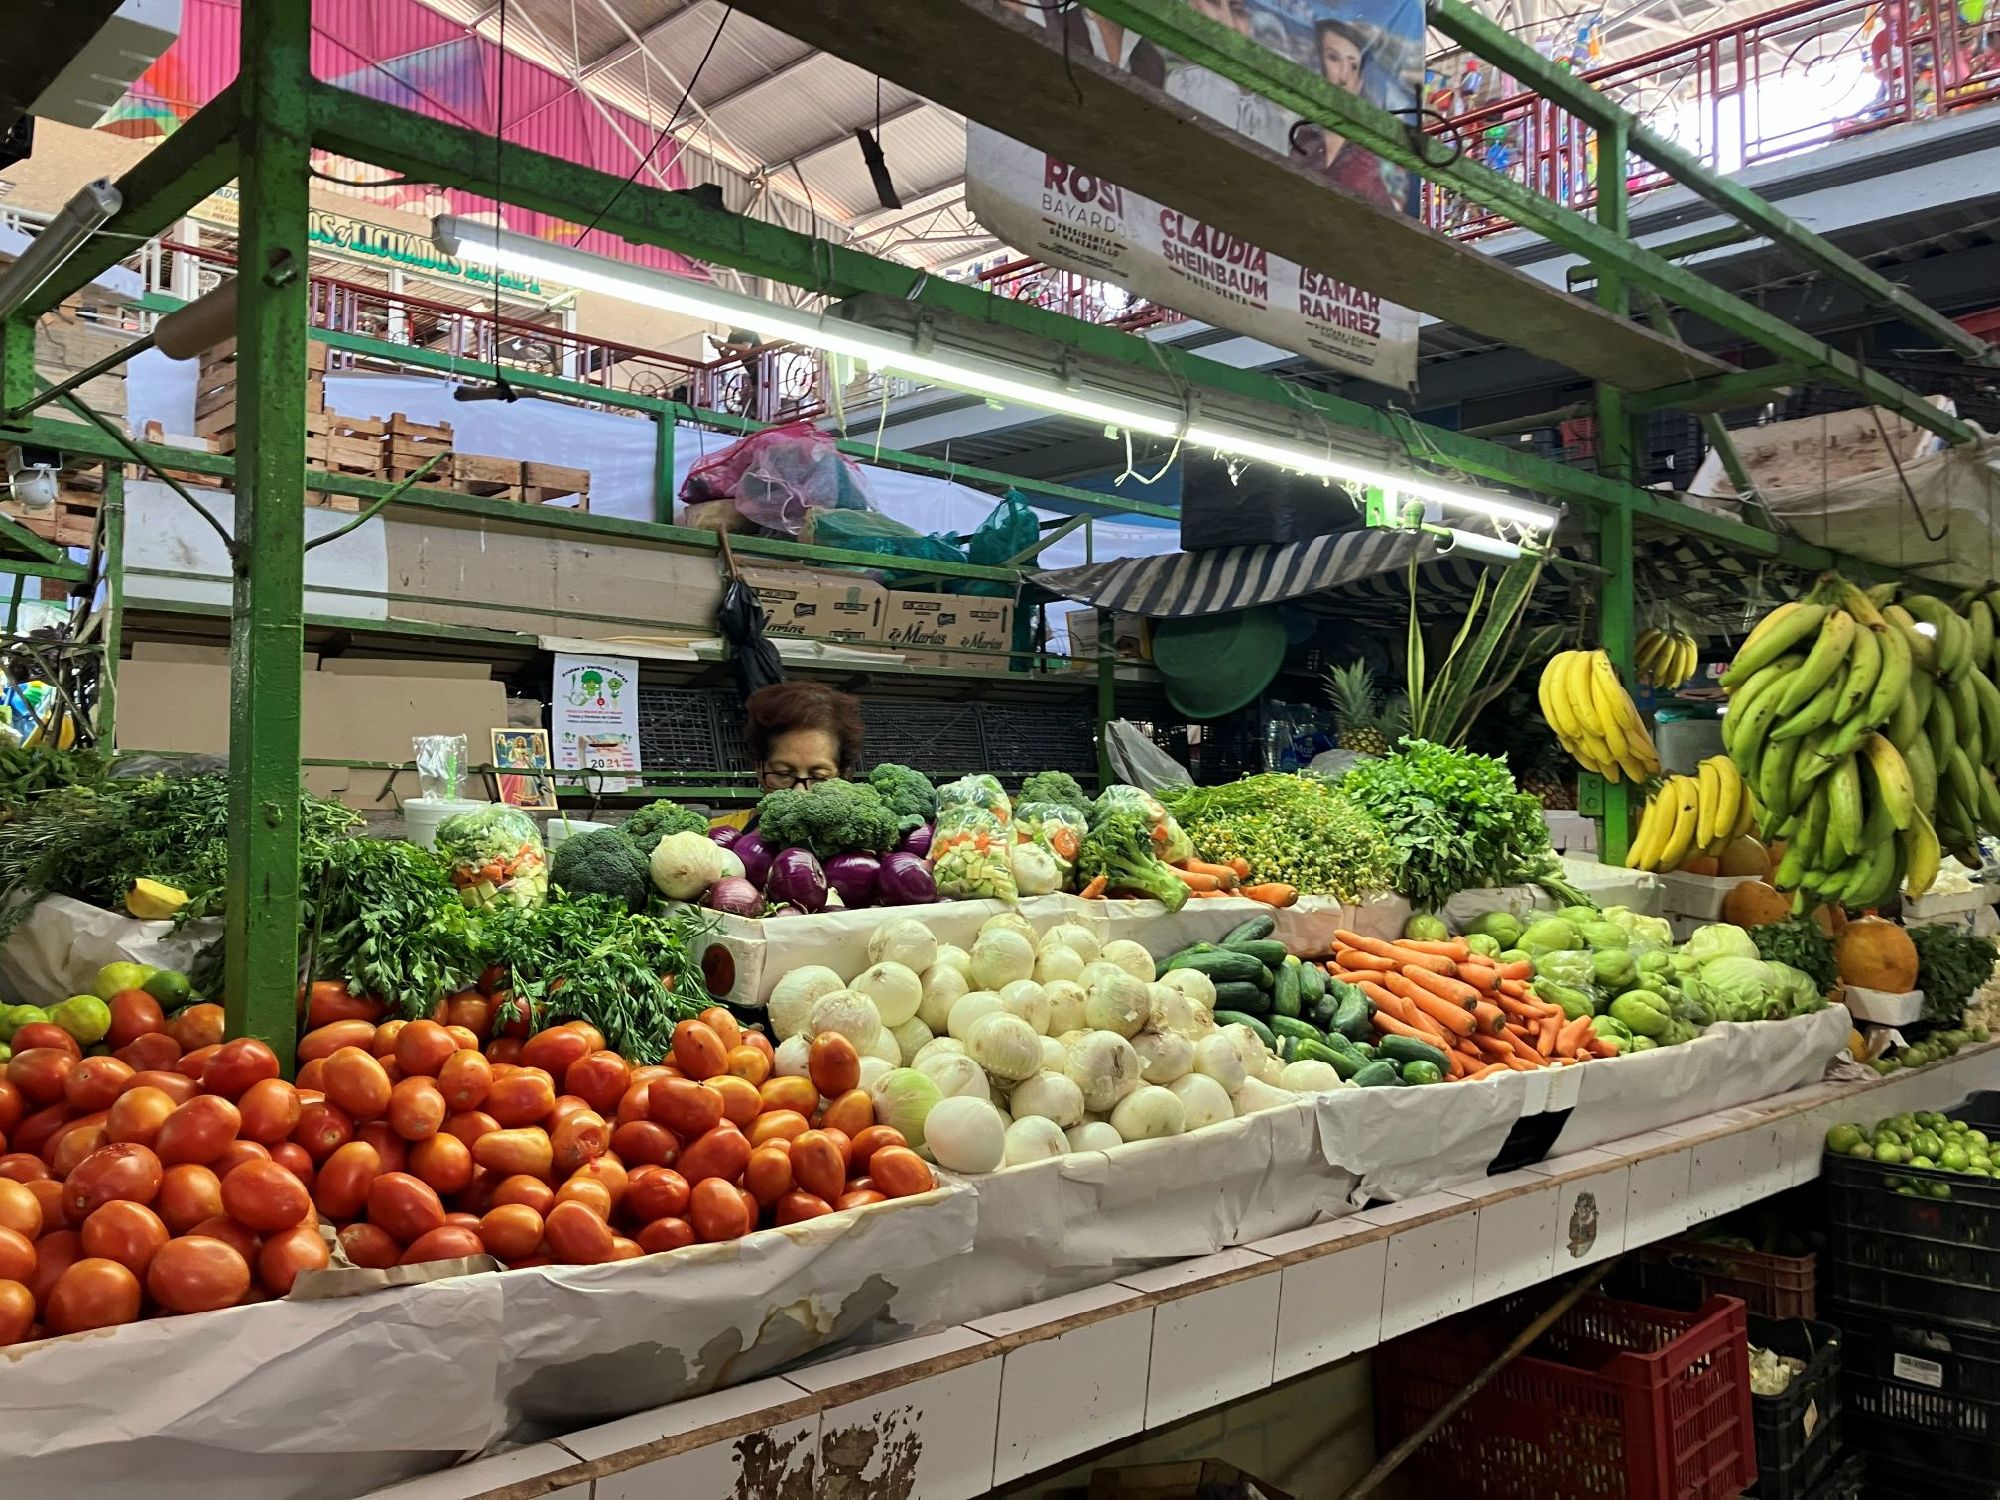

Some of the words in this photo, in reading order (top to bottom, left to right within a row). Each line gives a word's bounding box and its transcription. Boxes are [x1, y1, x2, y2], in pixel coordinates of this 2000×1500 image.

[1044, 154, 1124, 219] ROSI
[350, 221, 461, 275] LICUADOS
[1160, 208, 1268, 277] CLAUDIA
[1162, 238, 1268, 301] SHEINBAUM
[1299, 265, 1380, 315] ISAMAR
[1299, 293, 1380, 339] RAMIREZ
